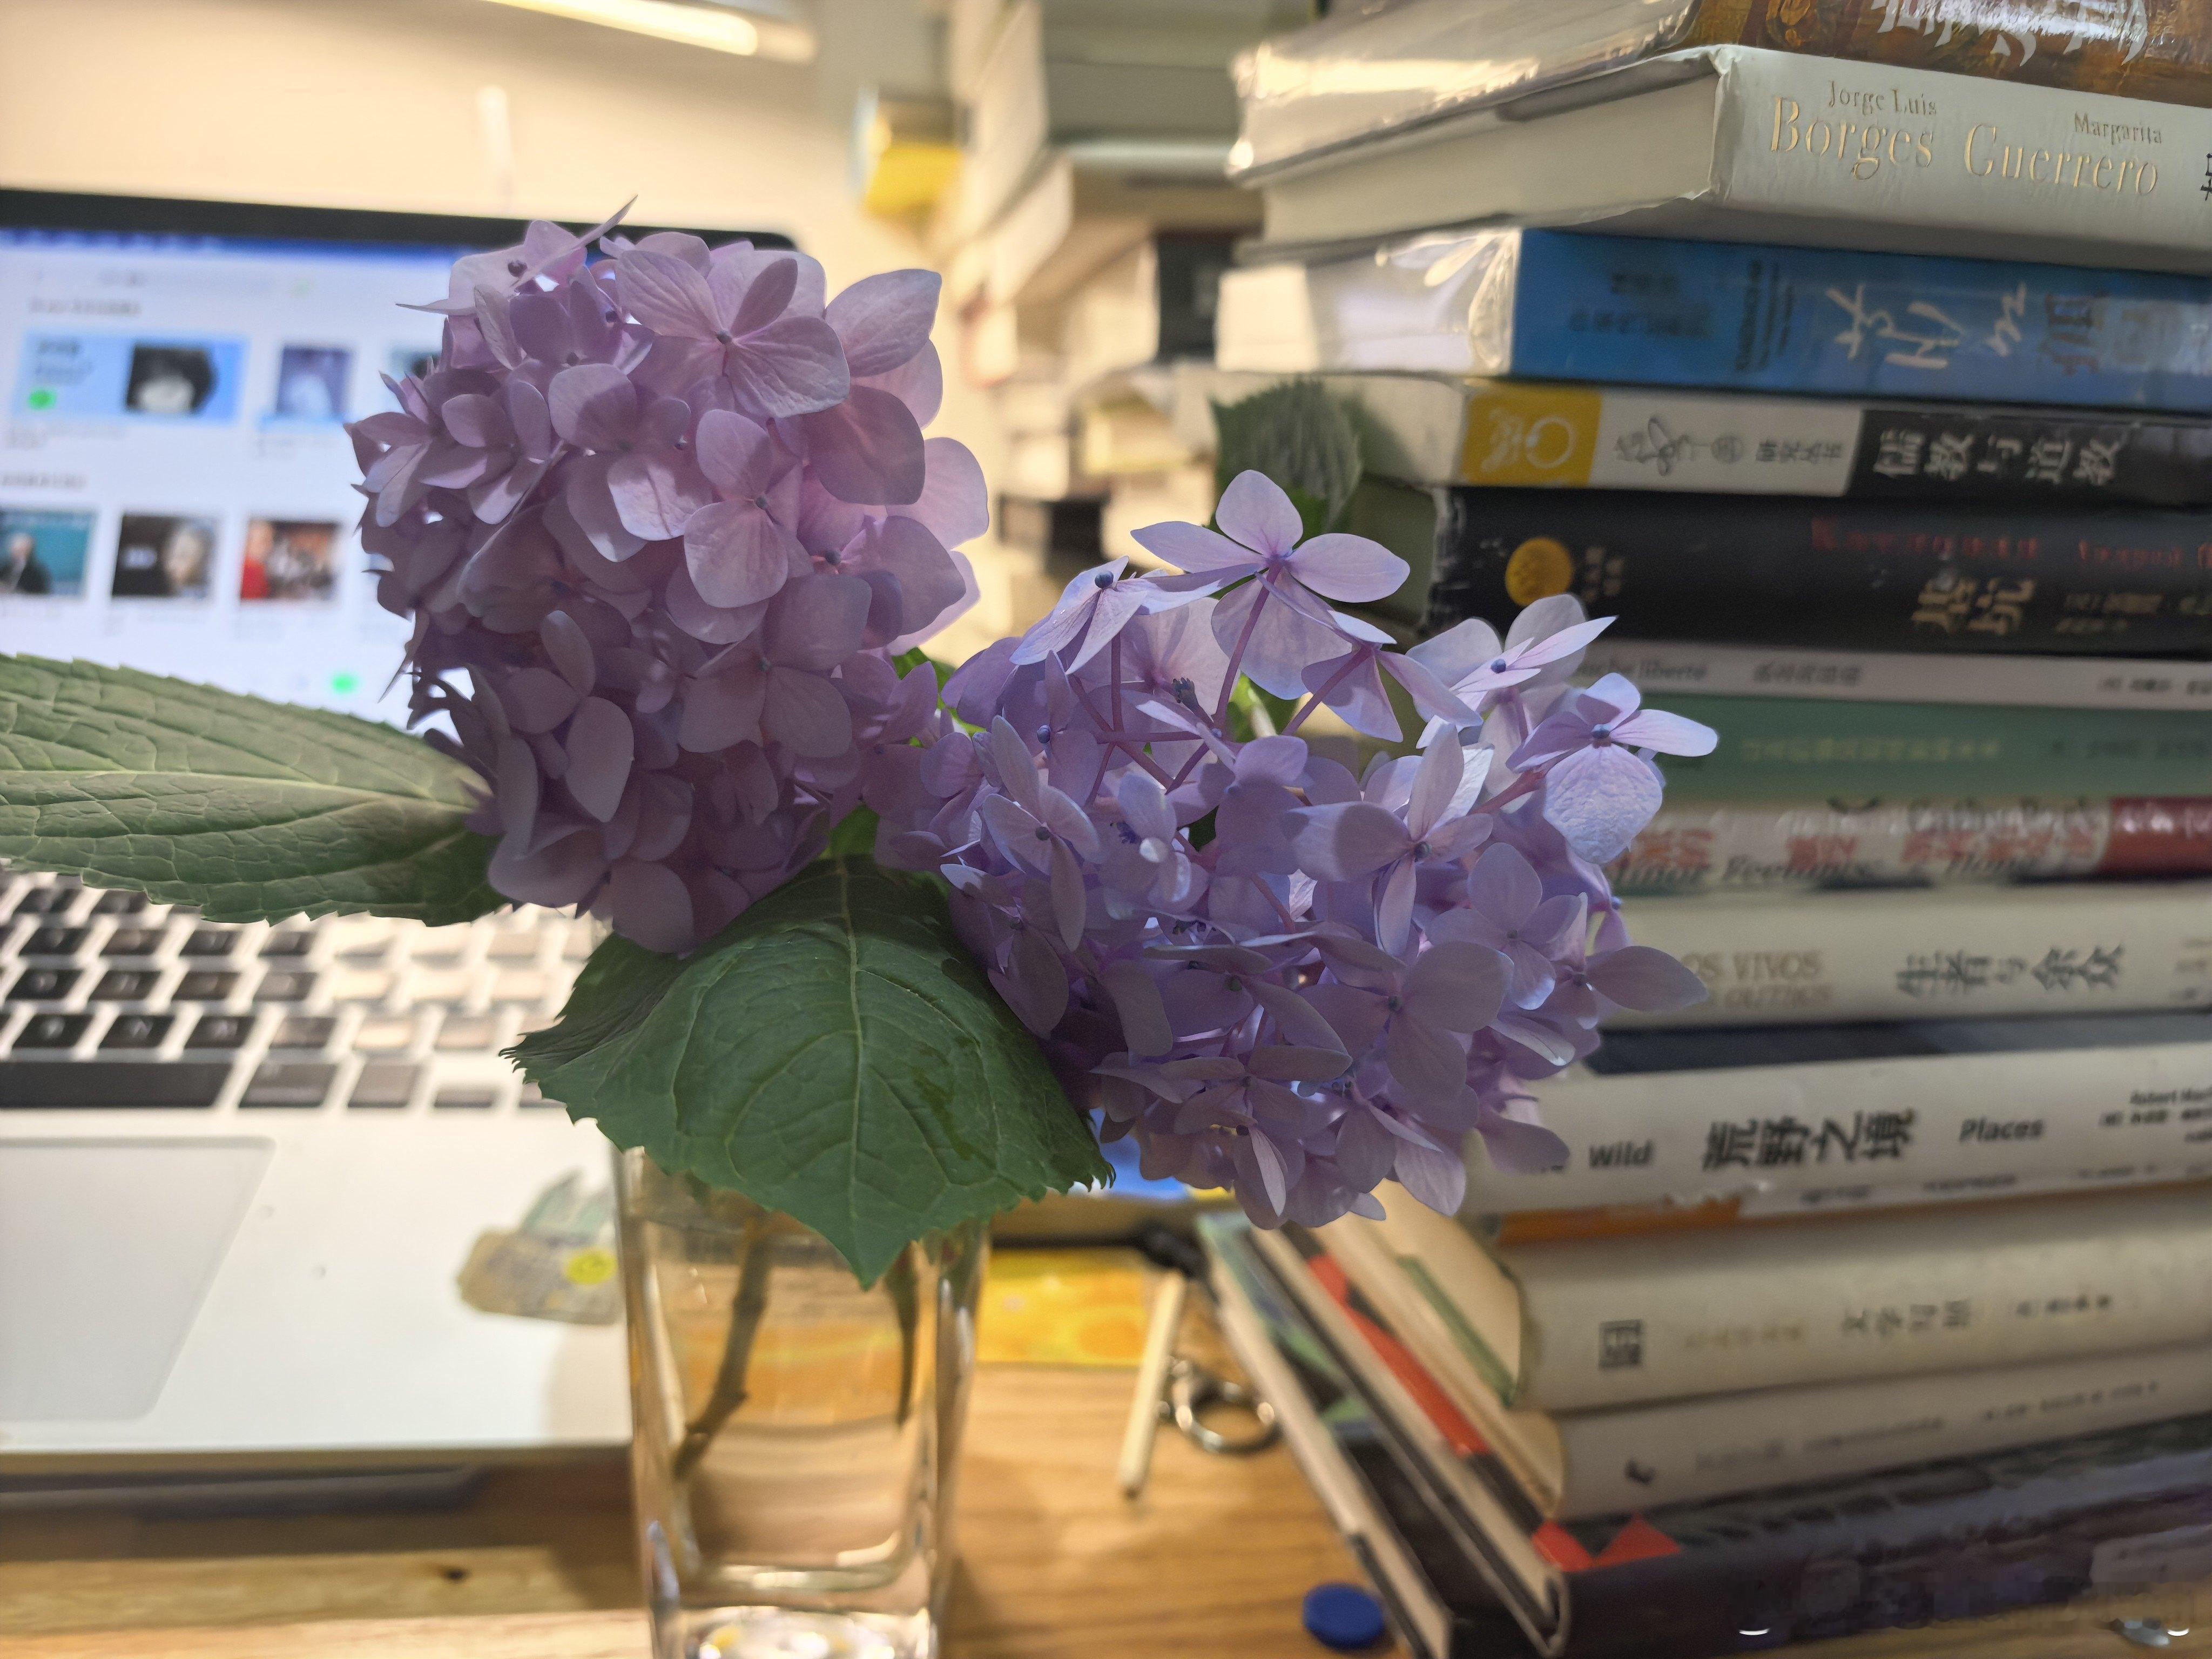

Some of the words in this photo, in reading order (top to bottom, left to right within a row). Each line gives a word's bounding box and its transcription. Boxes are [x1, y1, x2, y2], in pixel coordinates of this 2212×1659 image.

[1829, 80, 1884, 114] Jorge
[1894, 89, 1937, 117] Luis
[1770, 96, 1935, 180] Borges
[2074, 112, 2162, 145] Margarita
[1963, 123, 2160, 197] Guerrero
[1873, 430, 2119, 486] 儒教与道教
[1958, 1117, 2047, 1144] Places
[1588, 1138, 1655, 1171] Wild
